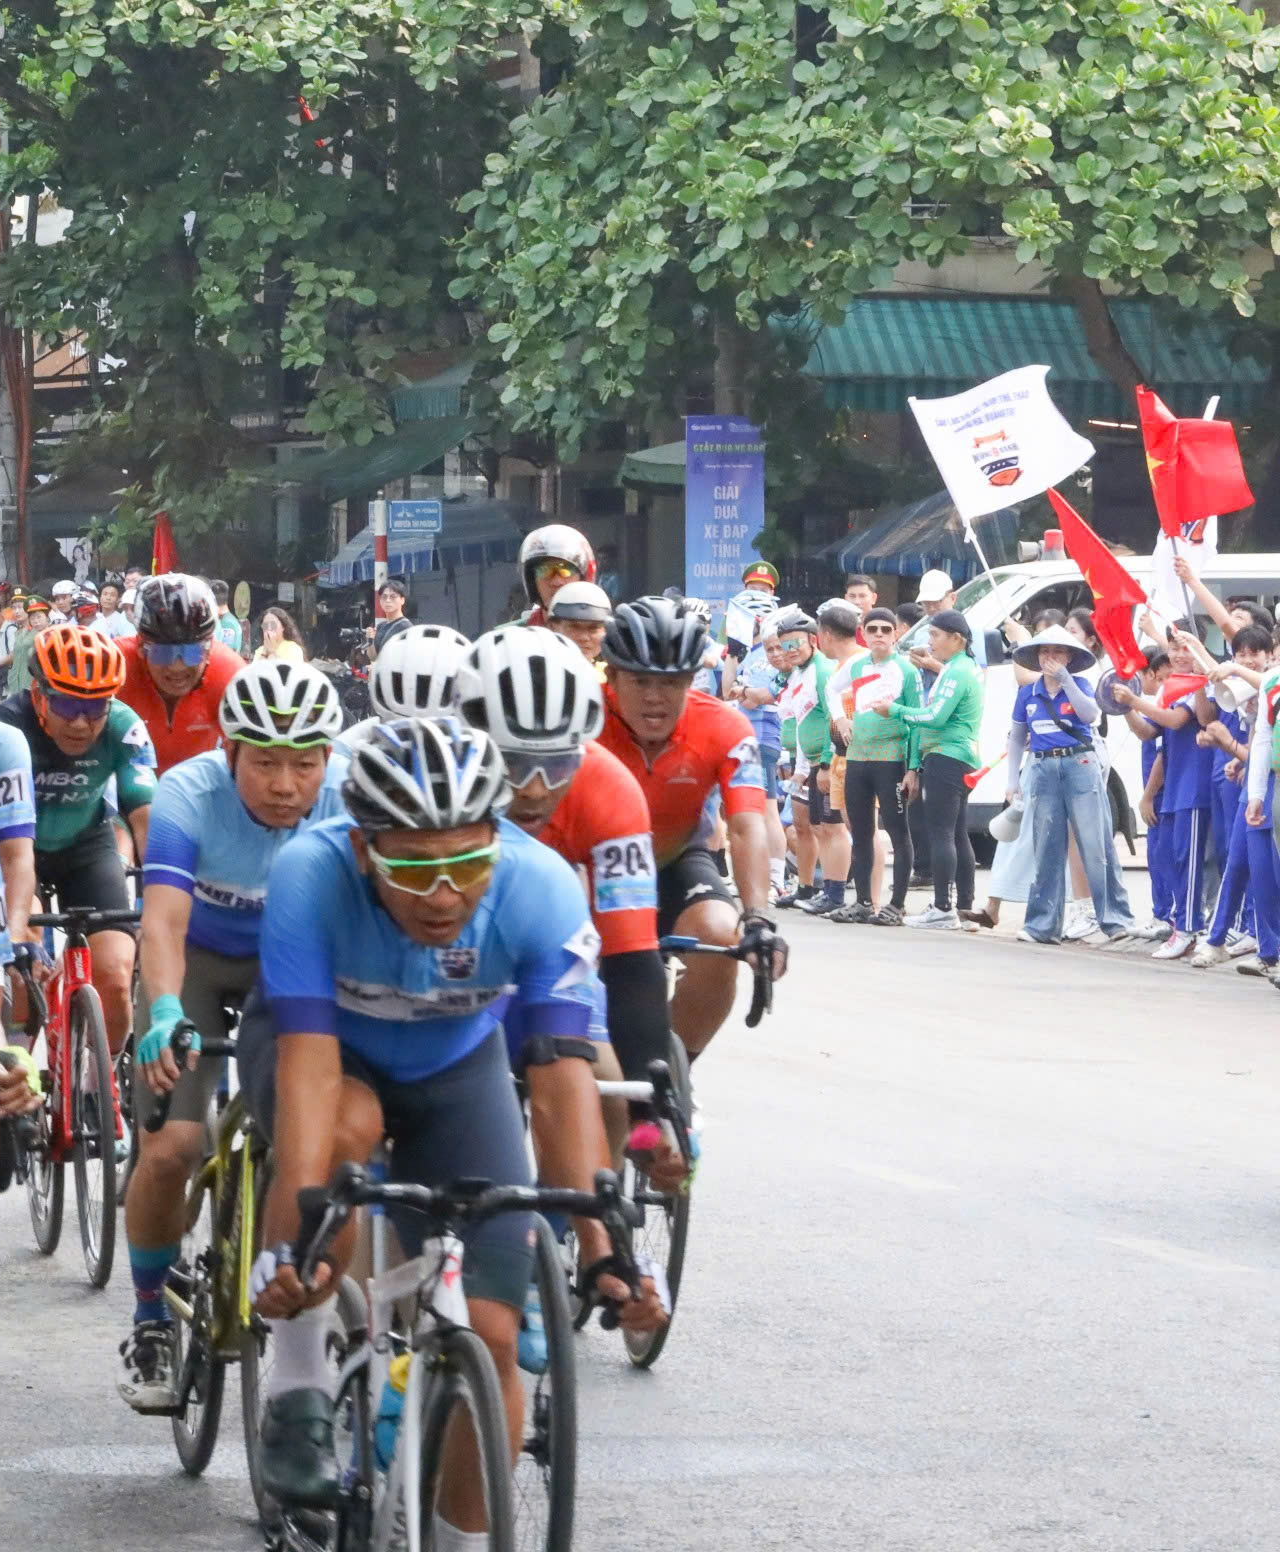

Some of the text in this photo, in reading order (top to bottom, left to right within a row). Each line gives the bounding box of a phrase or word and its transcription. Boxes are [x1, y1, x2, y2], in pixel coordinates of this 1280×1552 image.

[713, 482, 740, 499] GIẢI
[714, 505, 739, 519] ĐUA
[704, 525, 719, 539] XE
